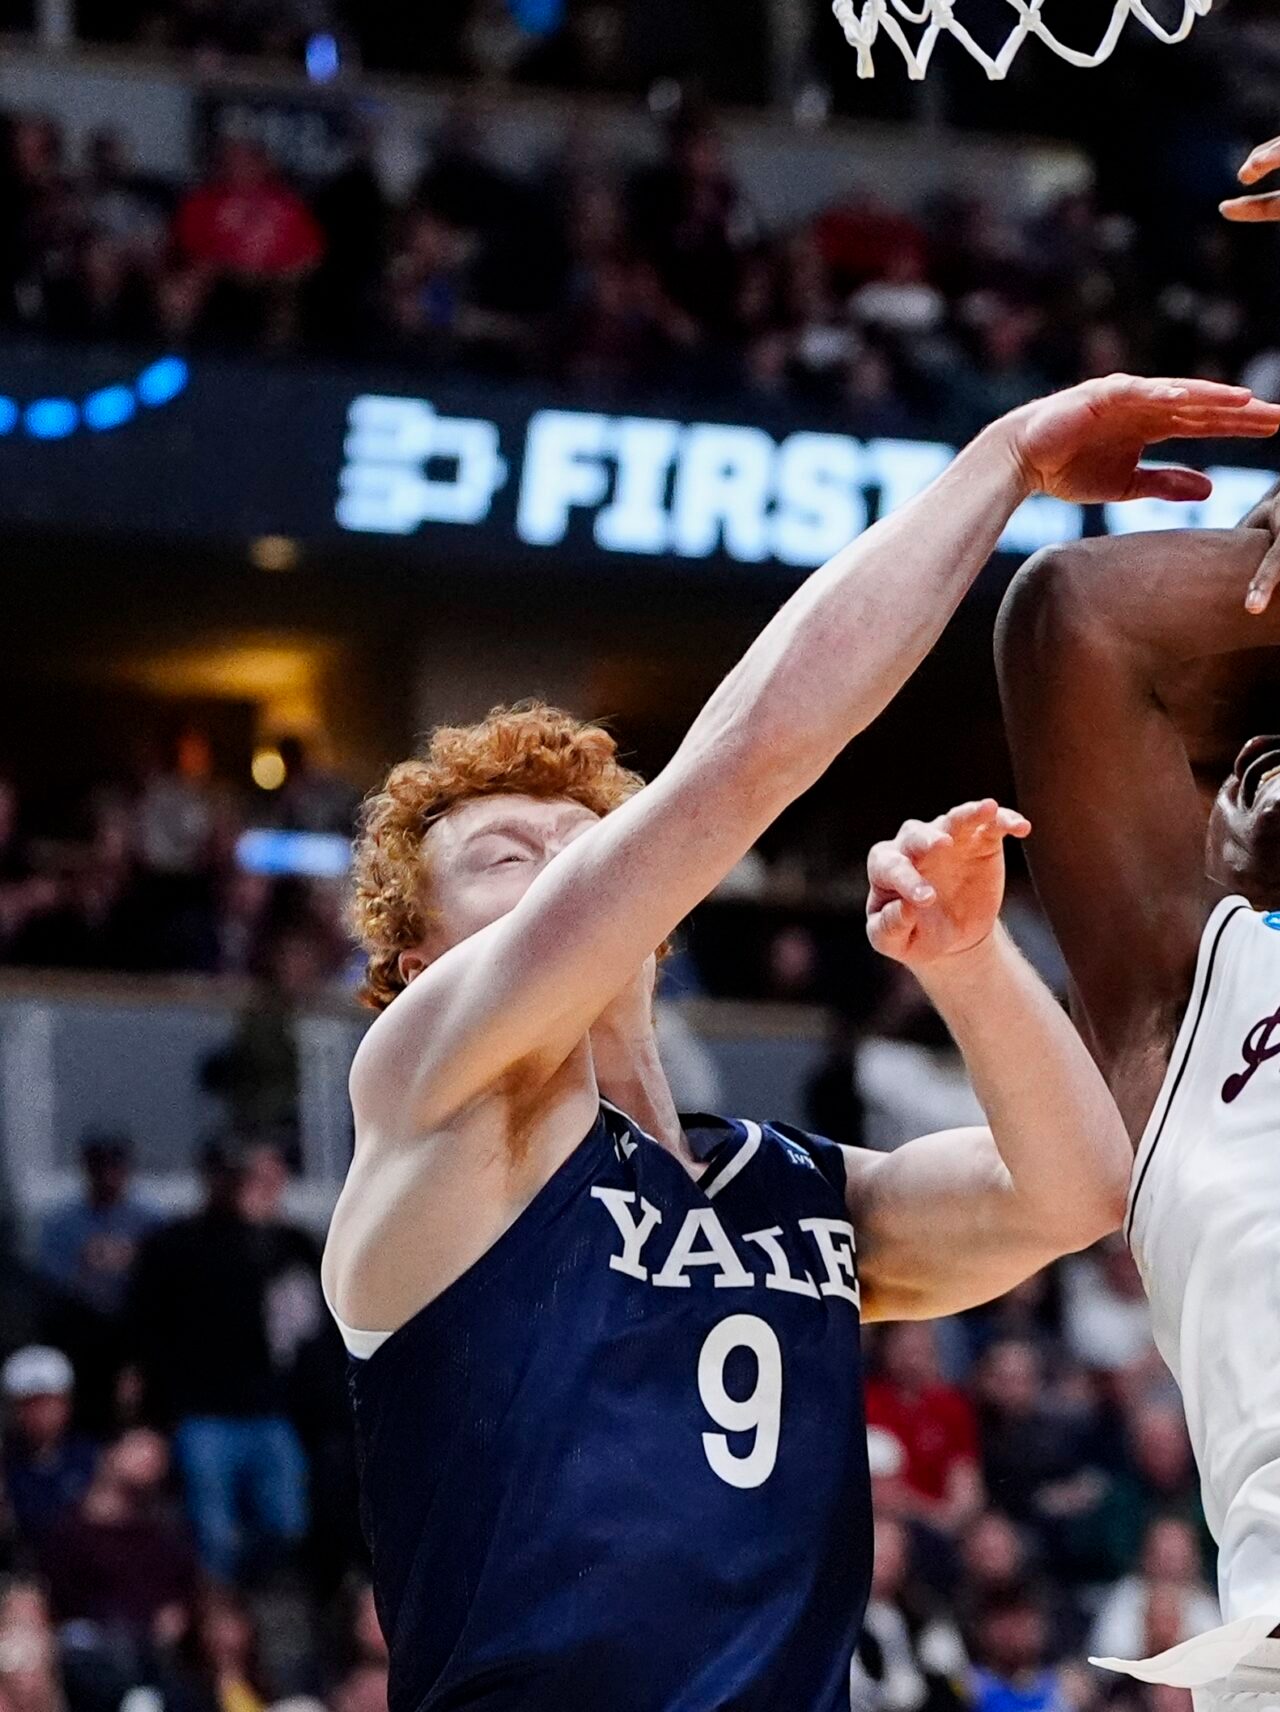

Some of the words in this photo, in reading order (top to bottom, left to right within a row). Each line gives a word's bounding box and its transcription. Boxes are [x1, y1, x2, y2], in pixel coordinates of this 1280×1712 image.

[516, 408, 955, 568] FIRST
[590, 1186, 861, 1312] YALE
[698, 1314, 782, 1489] 9
